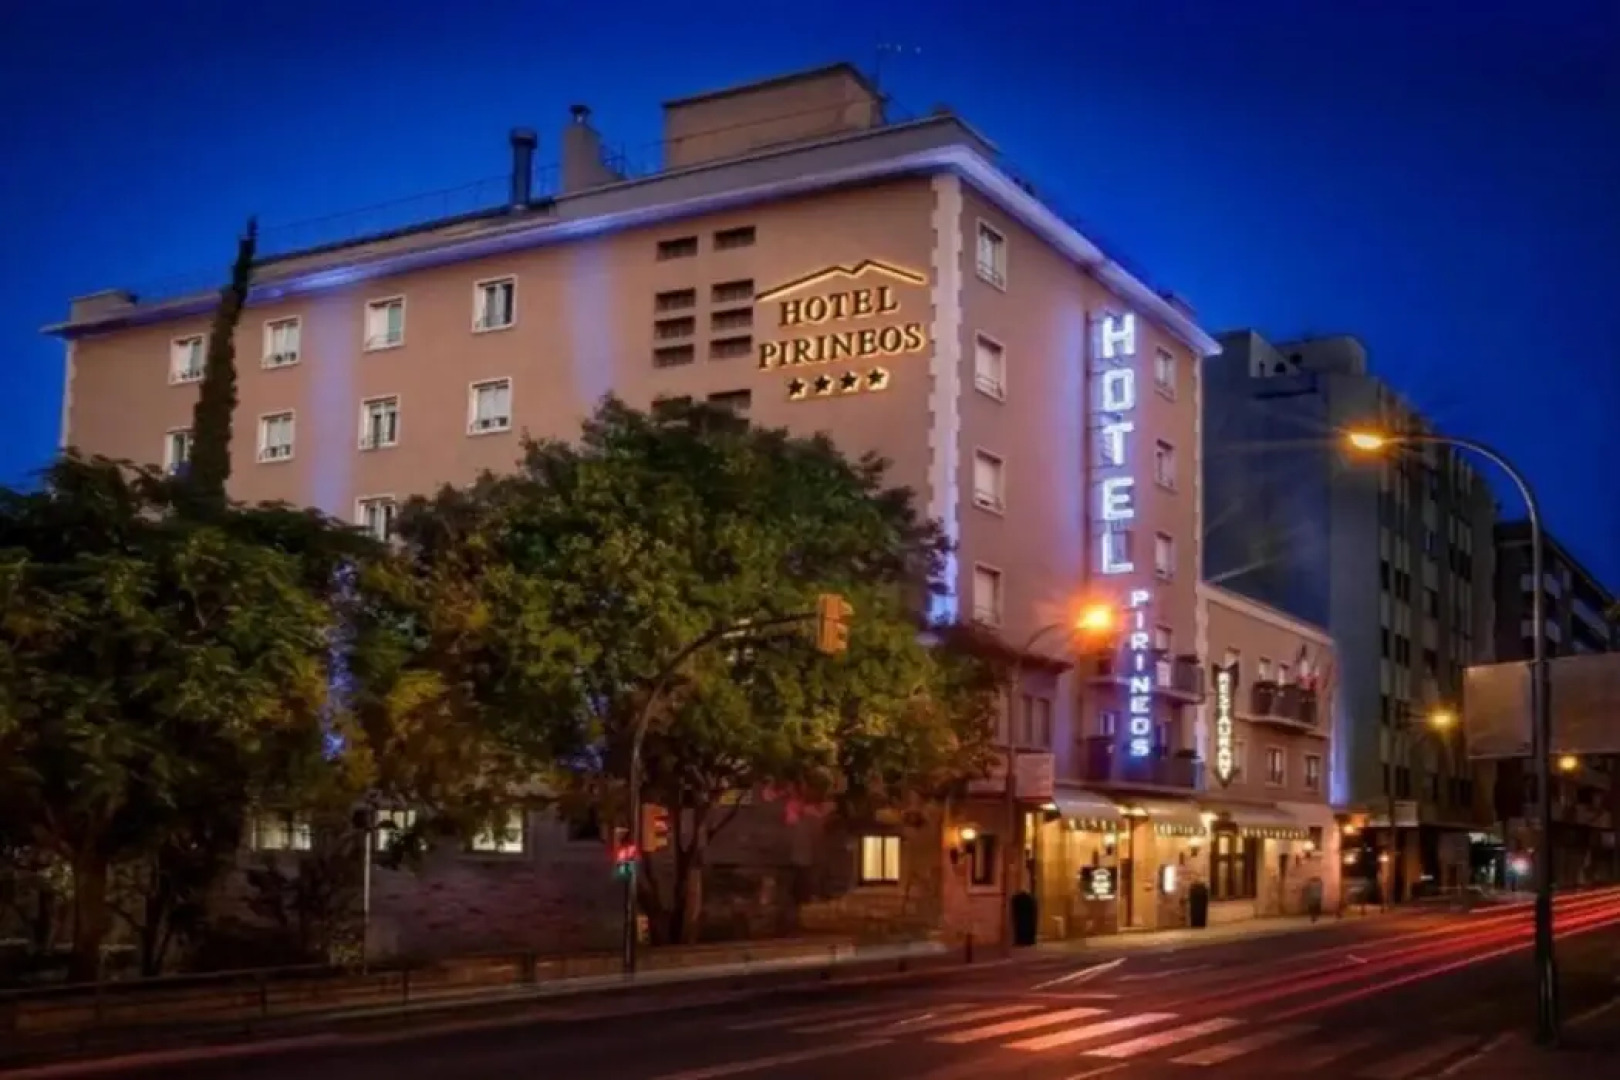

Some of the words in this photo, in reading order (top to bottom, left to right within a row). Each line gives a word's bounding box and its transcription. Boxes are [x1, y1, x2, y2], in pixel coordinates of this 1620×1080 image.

[758, 322, 922, 369] PIRINEOS
[778, 285, 898, 326] HOTEL
[1102, 313, 1135, 574] HOTEL
[1130, 590, 1150, 757] PIRINEOS
